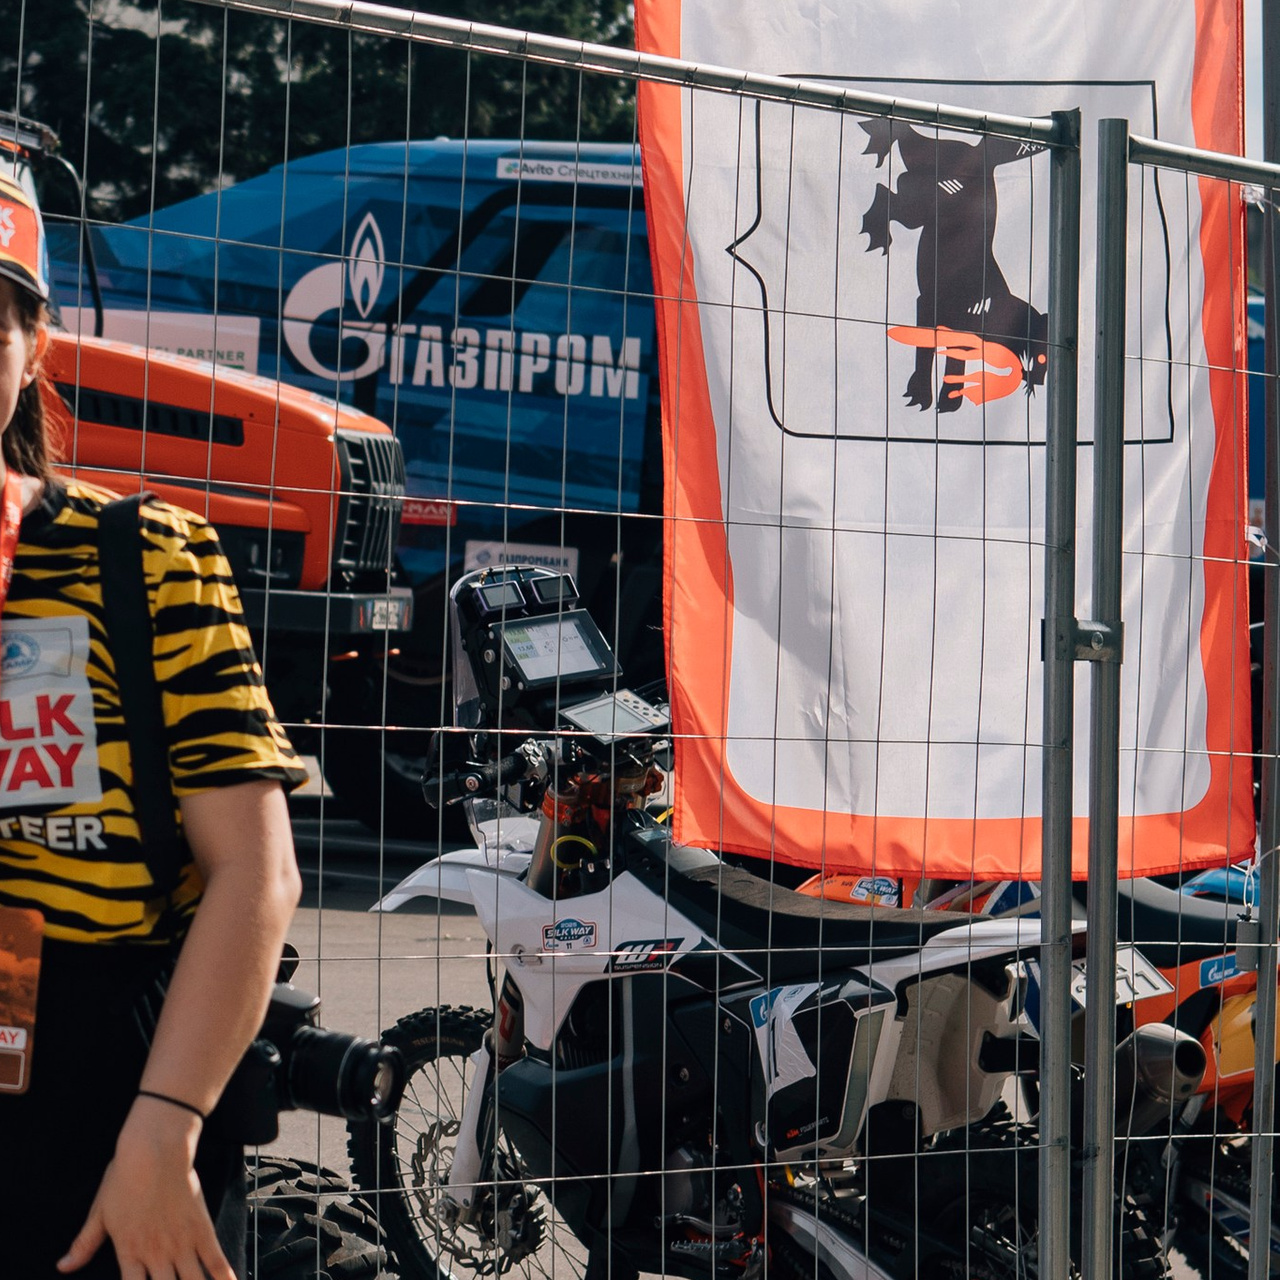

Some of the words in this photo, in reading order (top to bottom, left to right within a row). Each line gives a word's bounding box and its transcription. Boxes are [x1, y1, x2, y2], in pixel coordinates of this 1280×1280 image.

[521, 162, 554, 176] Avito
[558, 165, 642, 182] Спецтехник
[177, 348, 245, 361] PARTNER
[390, 323, 642, 400] ГАЗПРОМ
[547, 928, 569, 938] SILK
[570, 926, 591, 935] WAY
[613, 962, 663, 970] SUSPENSION
